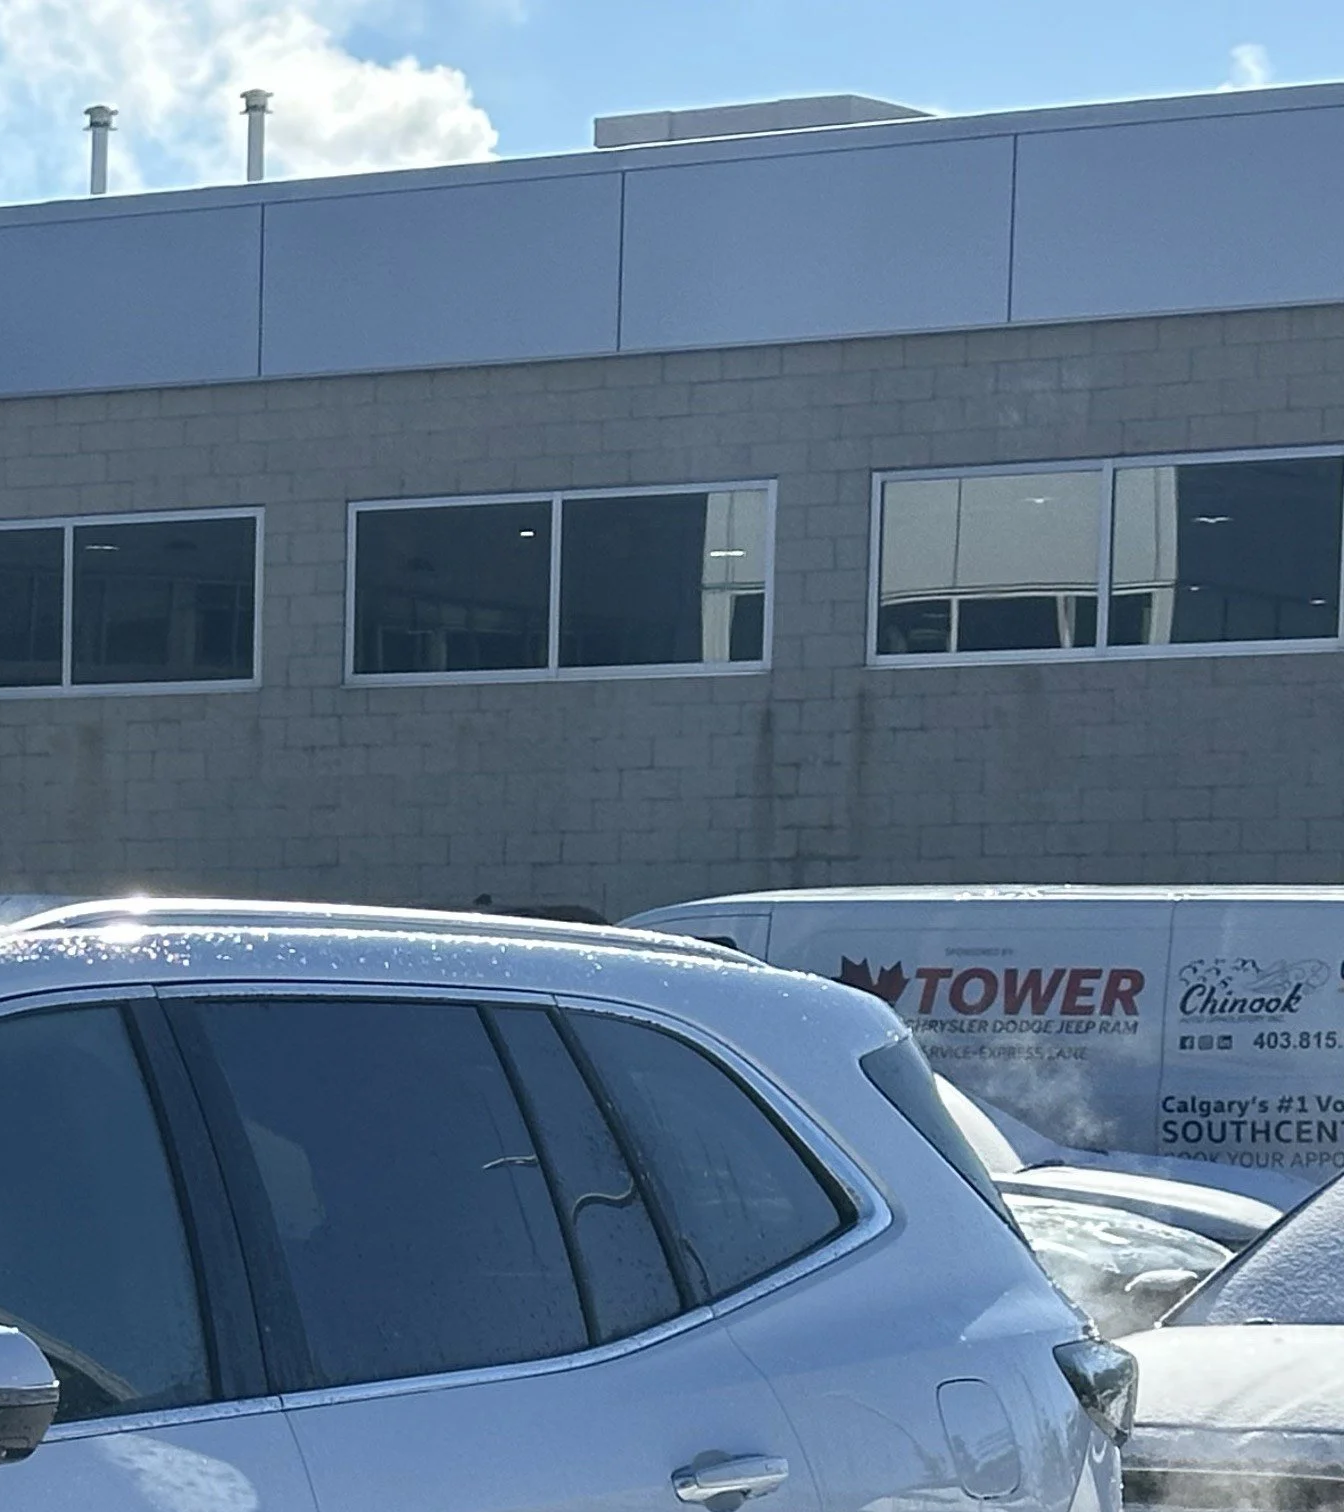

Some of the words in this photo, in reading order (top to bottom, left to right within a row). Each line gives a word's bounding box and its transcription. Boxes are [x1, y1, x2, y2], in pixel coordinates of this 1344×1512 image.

[915, 967, 1145, 1016] TOWER
[1179, 983, 1303, 1015] Chinook
[992, 1019, 1055, 1034] DODGE
[1056, 1019, 1097, 1034] JEEP
[1098, 1019, 1139, 1034] RAM
[1162, 1095, 1269, 1117] Calgary's
[1277, 1095, 1309, 1113] #1
[1226, 1151, 1284, 1169] YOUR
